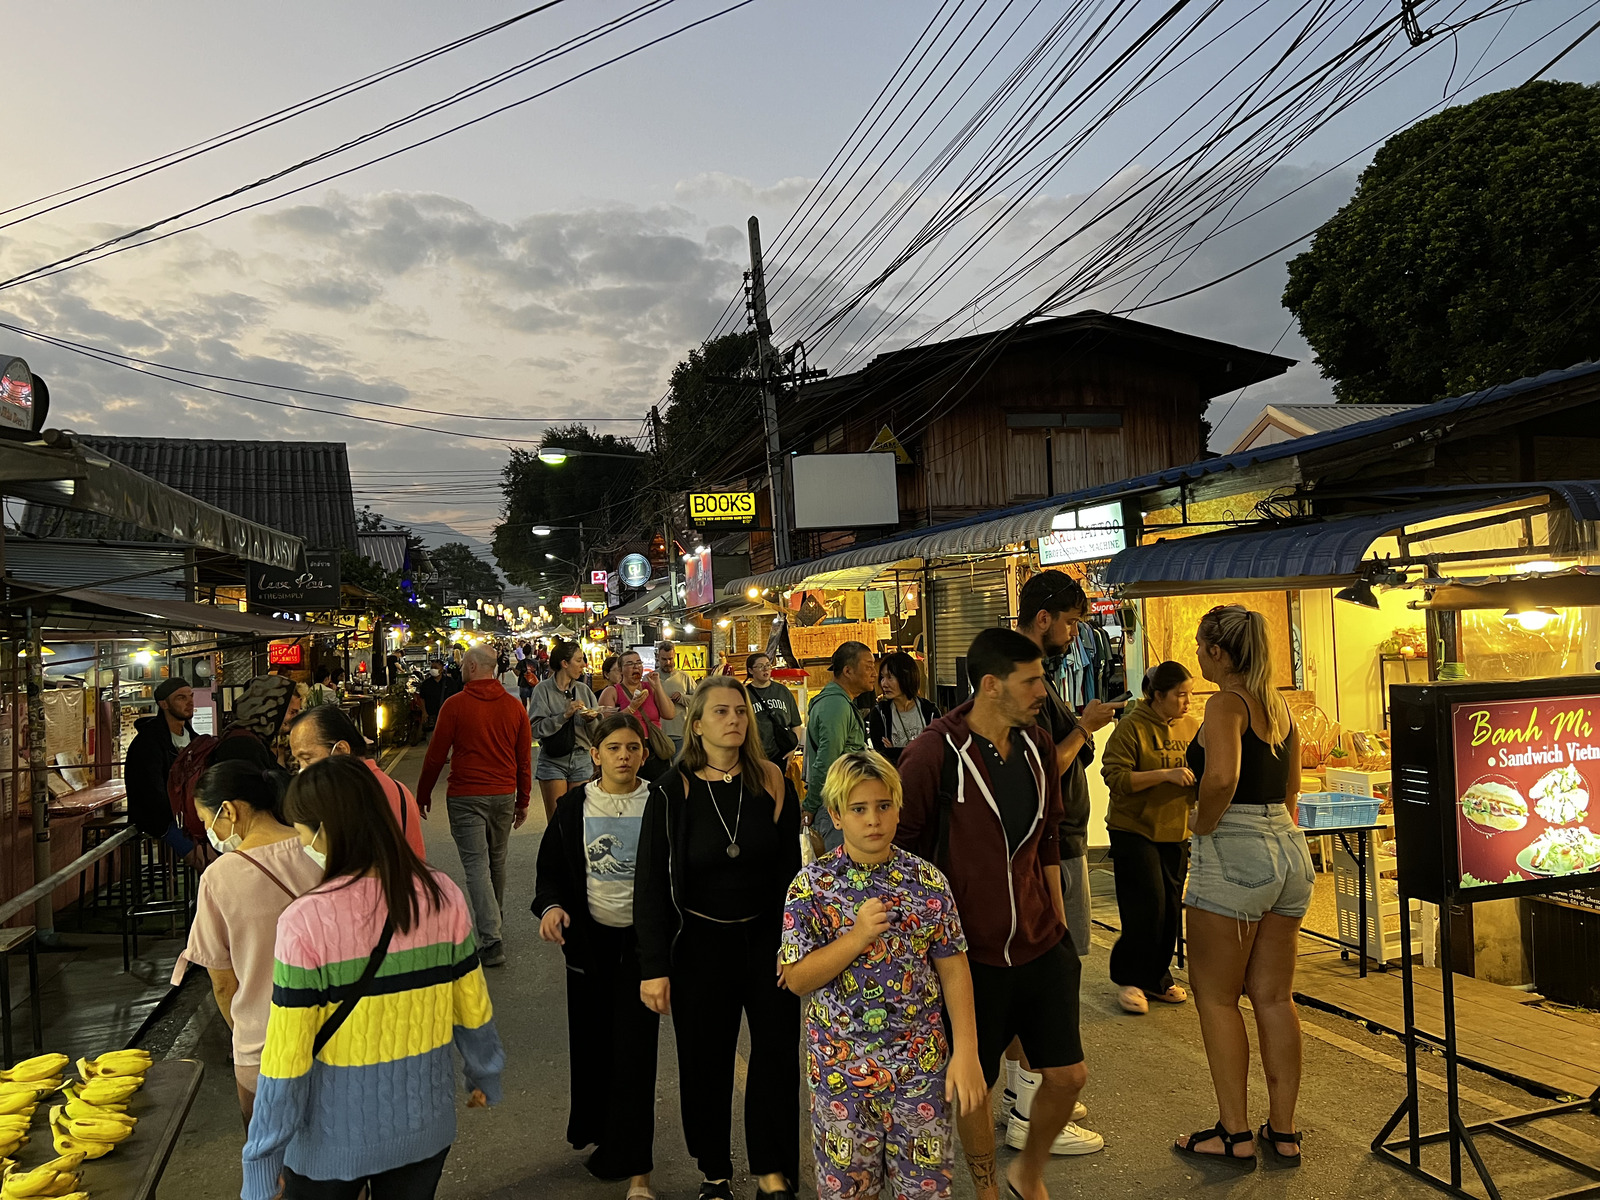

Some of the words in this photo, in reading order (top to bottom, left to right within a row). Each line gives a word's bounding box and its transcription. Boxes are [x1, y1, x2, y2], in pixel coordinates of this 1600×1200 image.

[694, 495, 752, 513] BOOKS
[1088, 540, 1121, 552] MACHINE
[272, 646, 298, 656] HEART
[673, 652, 705, 670] IAM
[767, 698, 788, 713] SODA
[1468, 706, 1543, 747] Banh
[1549, 708, 1593, 741] Mi
[1160, 753, 1171, 768] it
[1498, 744, 1564, 768] Sandwich
